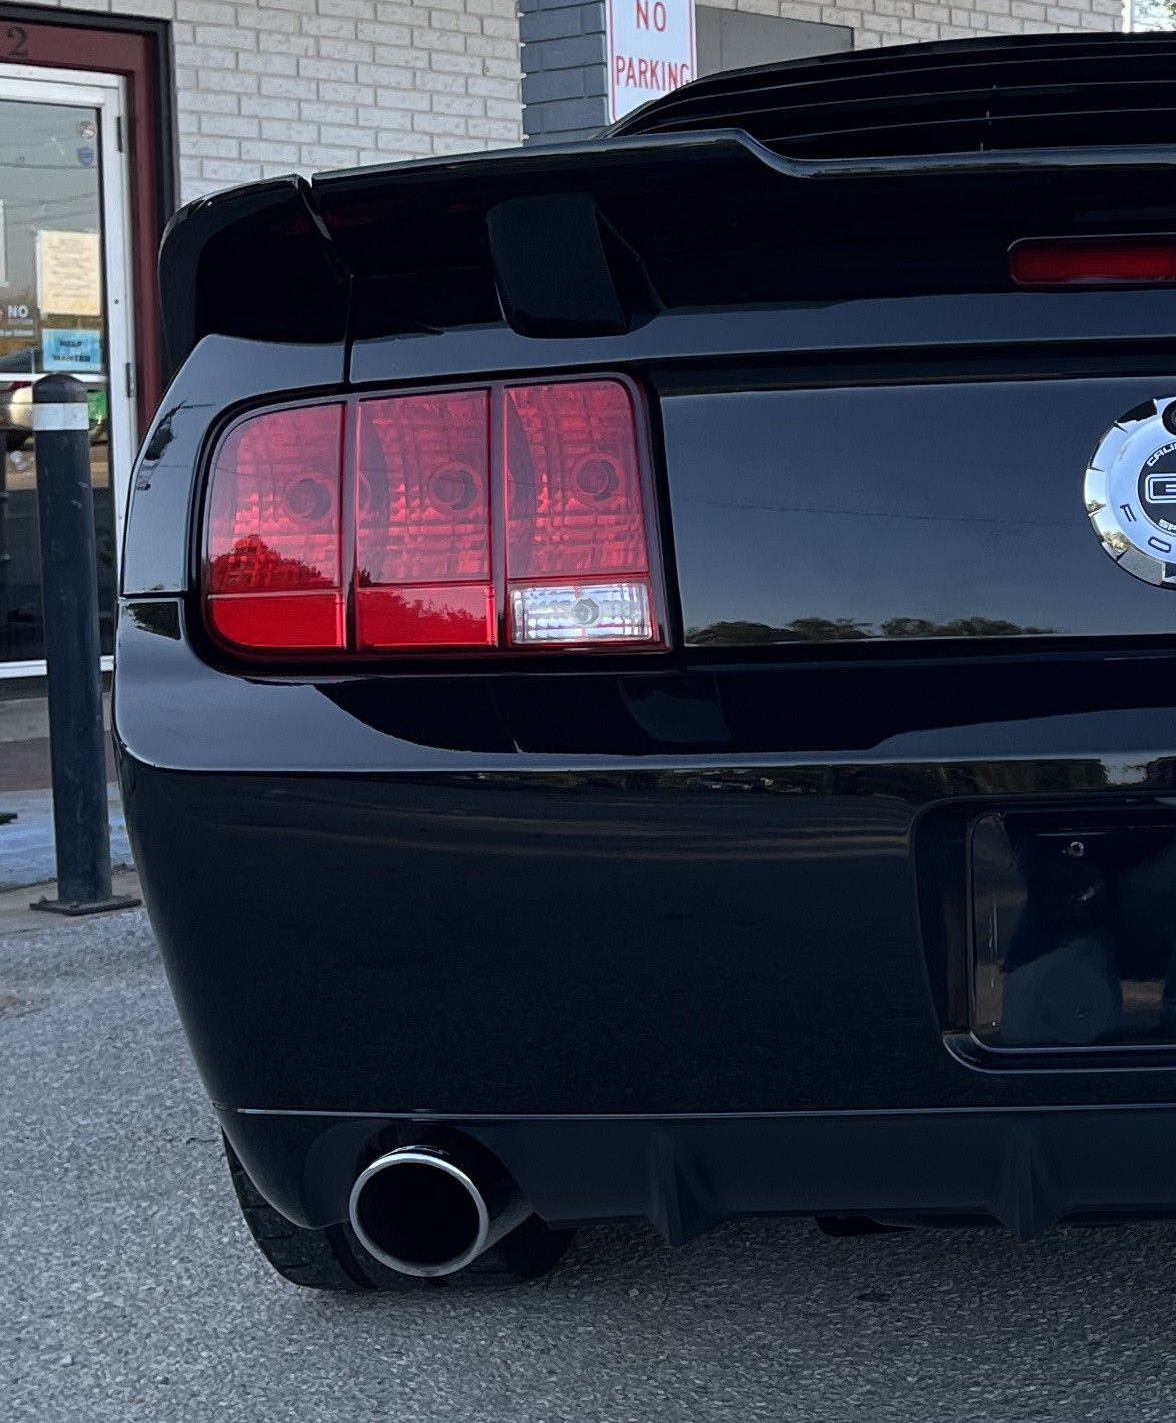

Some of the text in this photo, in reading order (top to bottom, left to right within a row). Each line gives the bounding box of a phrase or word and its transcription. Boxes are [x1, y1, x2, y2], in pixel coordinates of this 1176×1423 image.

[635, 0, 667, 33] NO
[7, 26, 29, 57] 2
[615, 55, 690, 91] PARKING
[7, 305, 29, 319] NO
